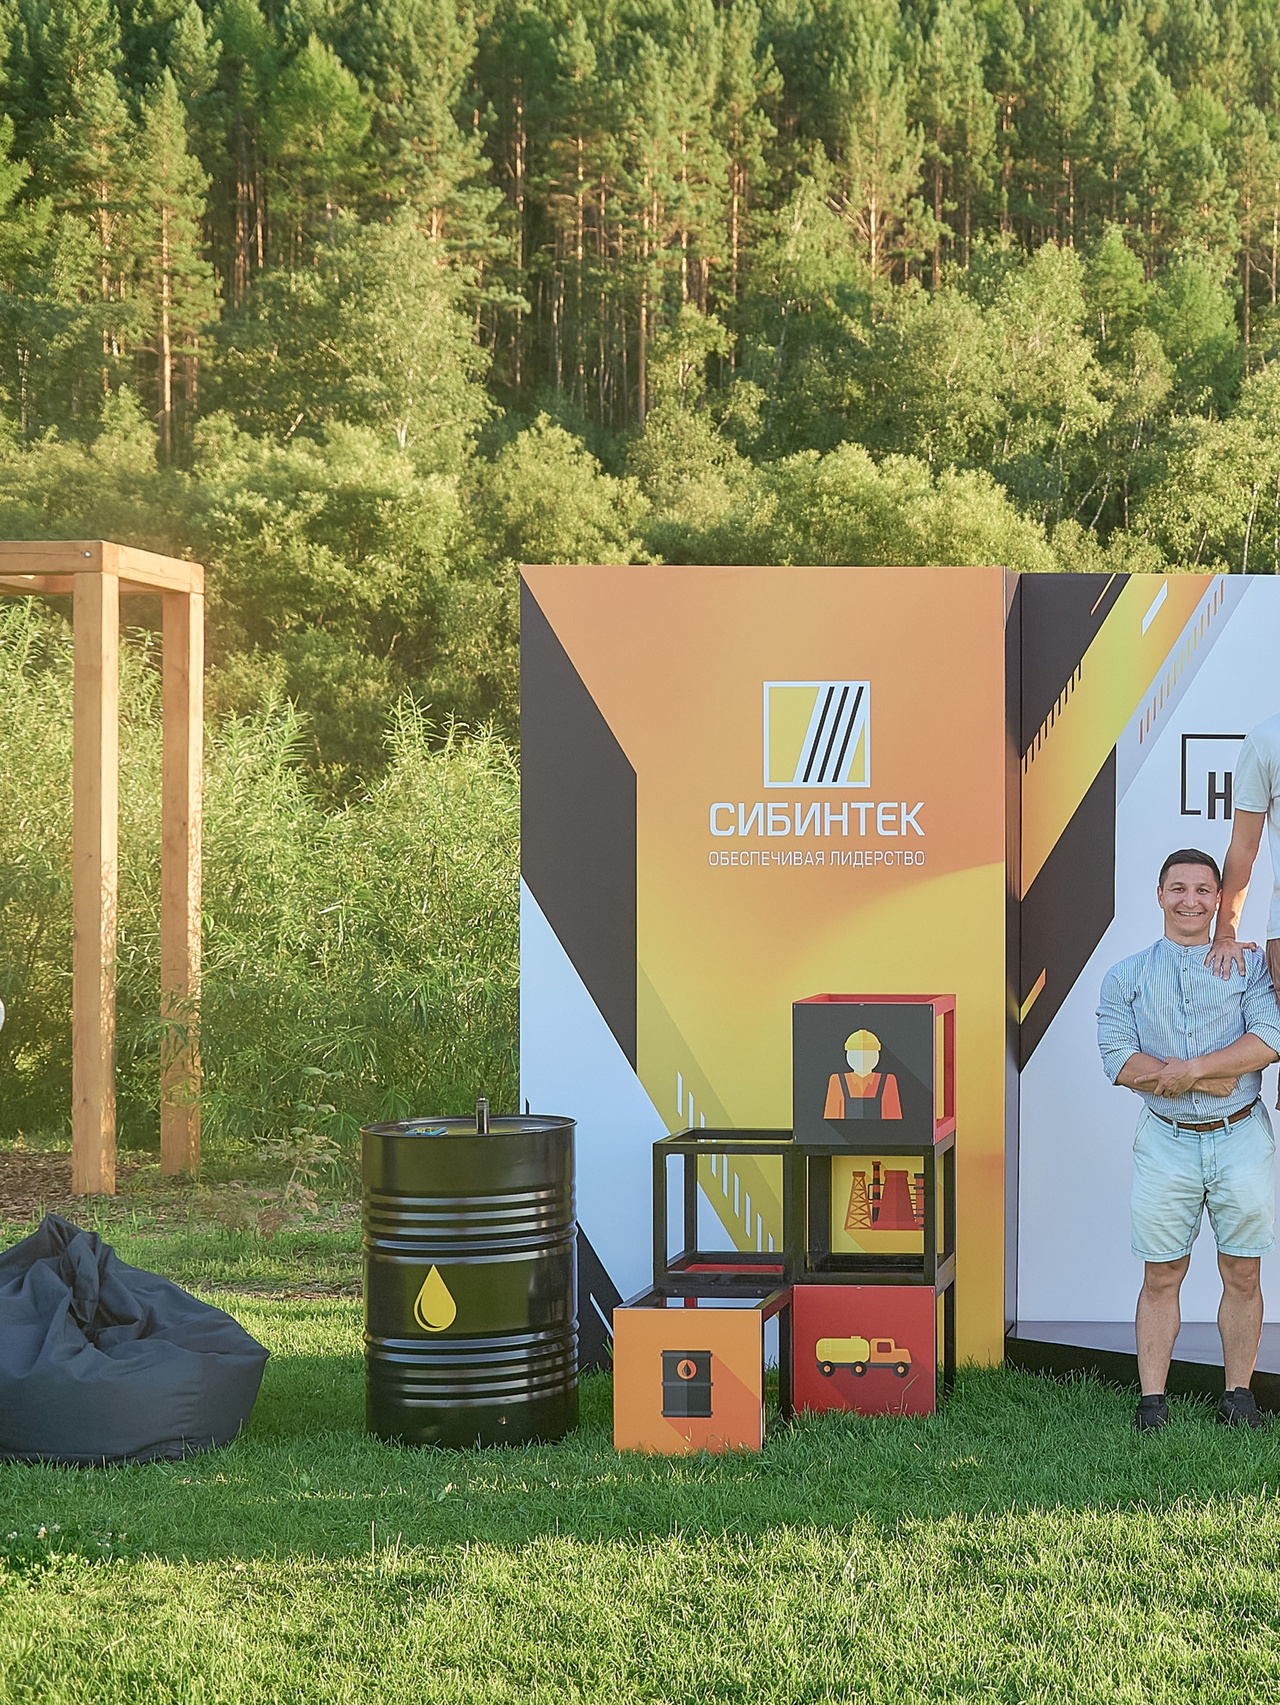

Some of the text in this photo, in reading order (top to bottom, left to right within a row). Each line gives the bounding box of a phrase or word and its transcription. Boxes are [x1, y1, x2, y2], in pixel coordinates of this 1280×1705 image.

[709, 802, 925, 837] СИБИНТЕК
[708, 850, 925, 868] ОБЕСПЕЧИВАЯ ЛИДЕРСТВО
